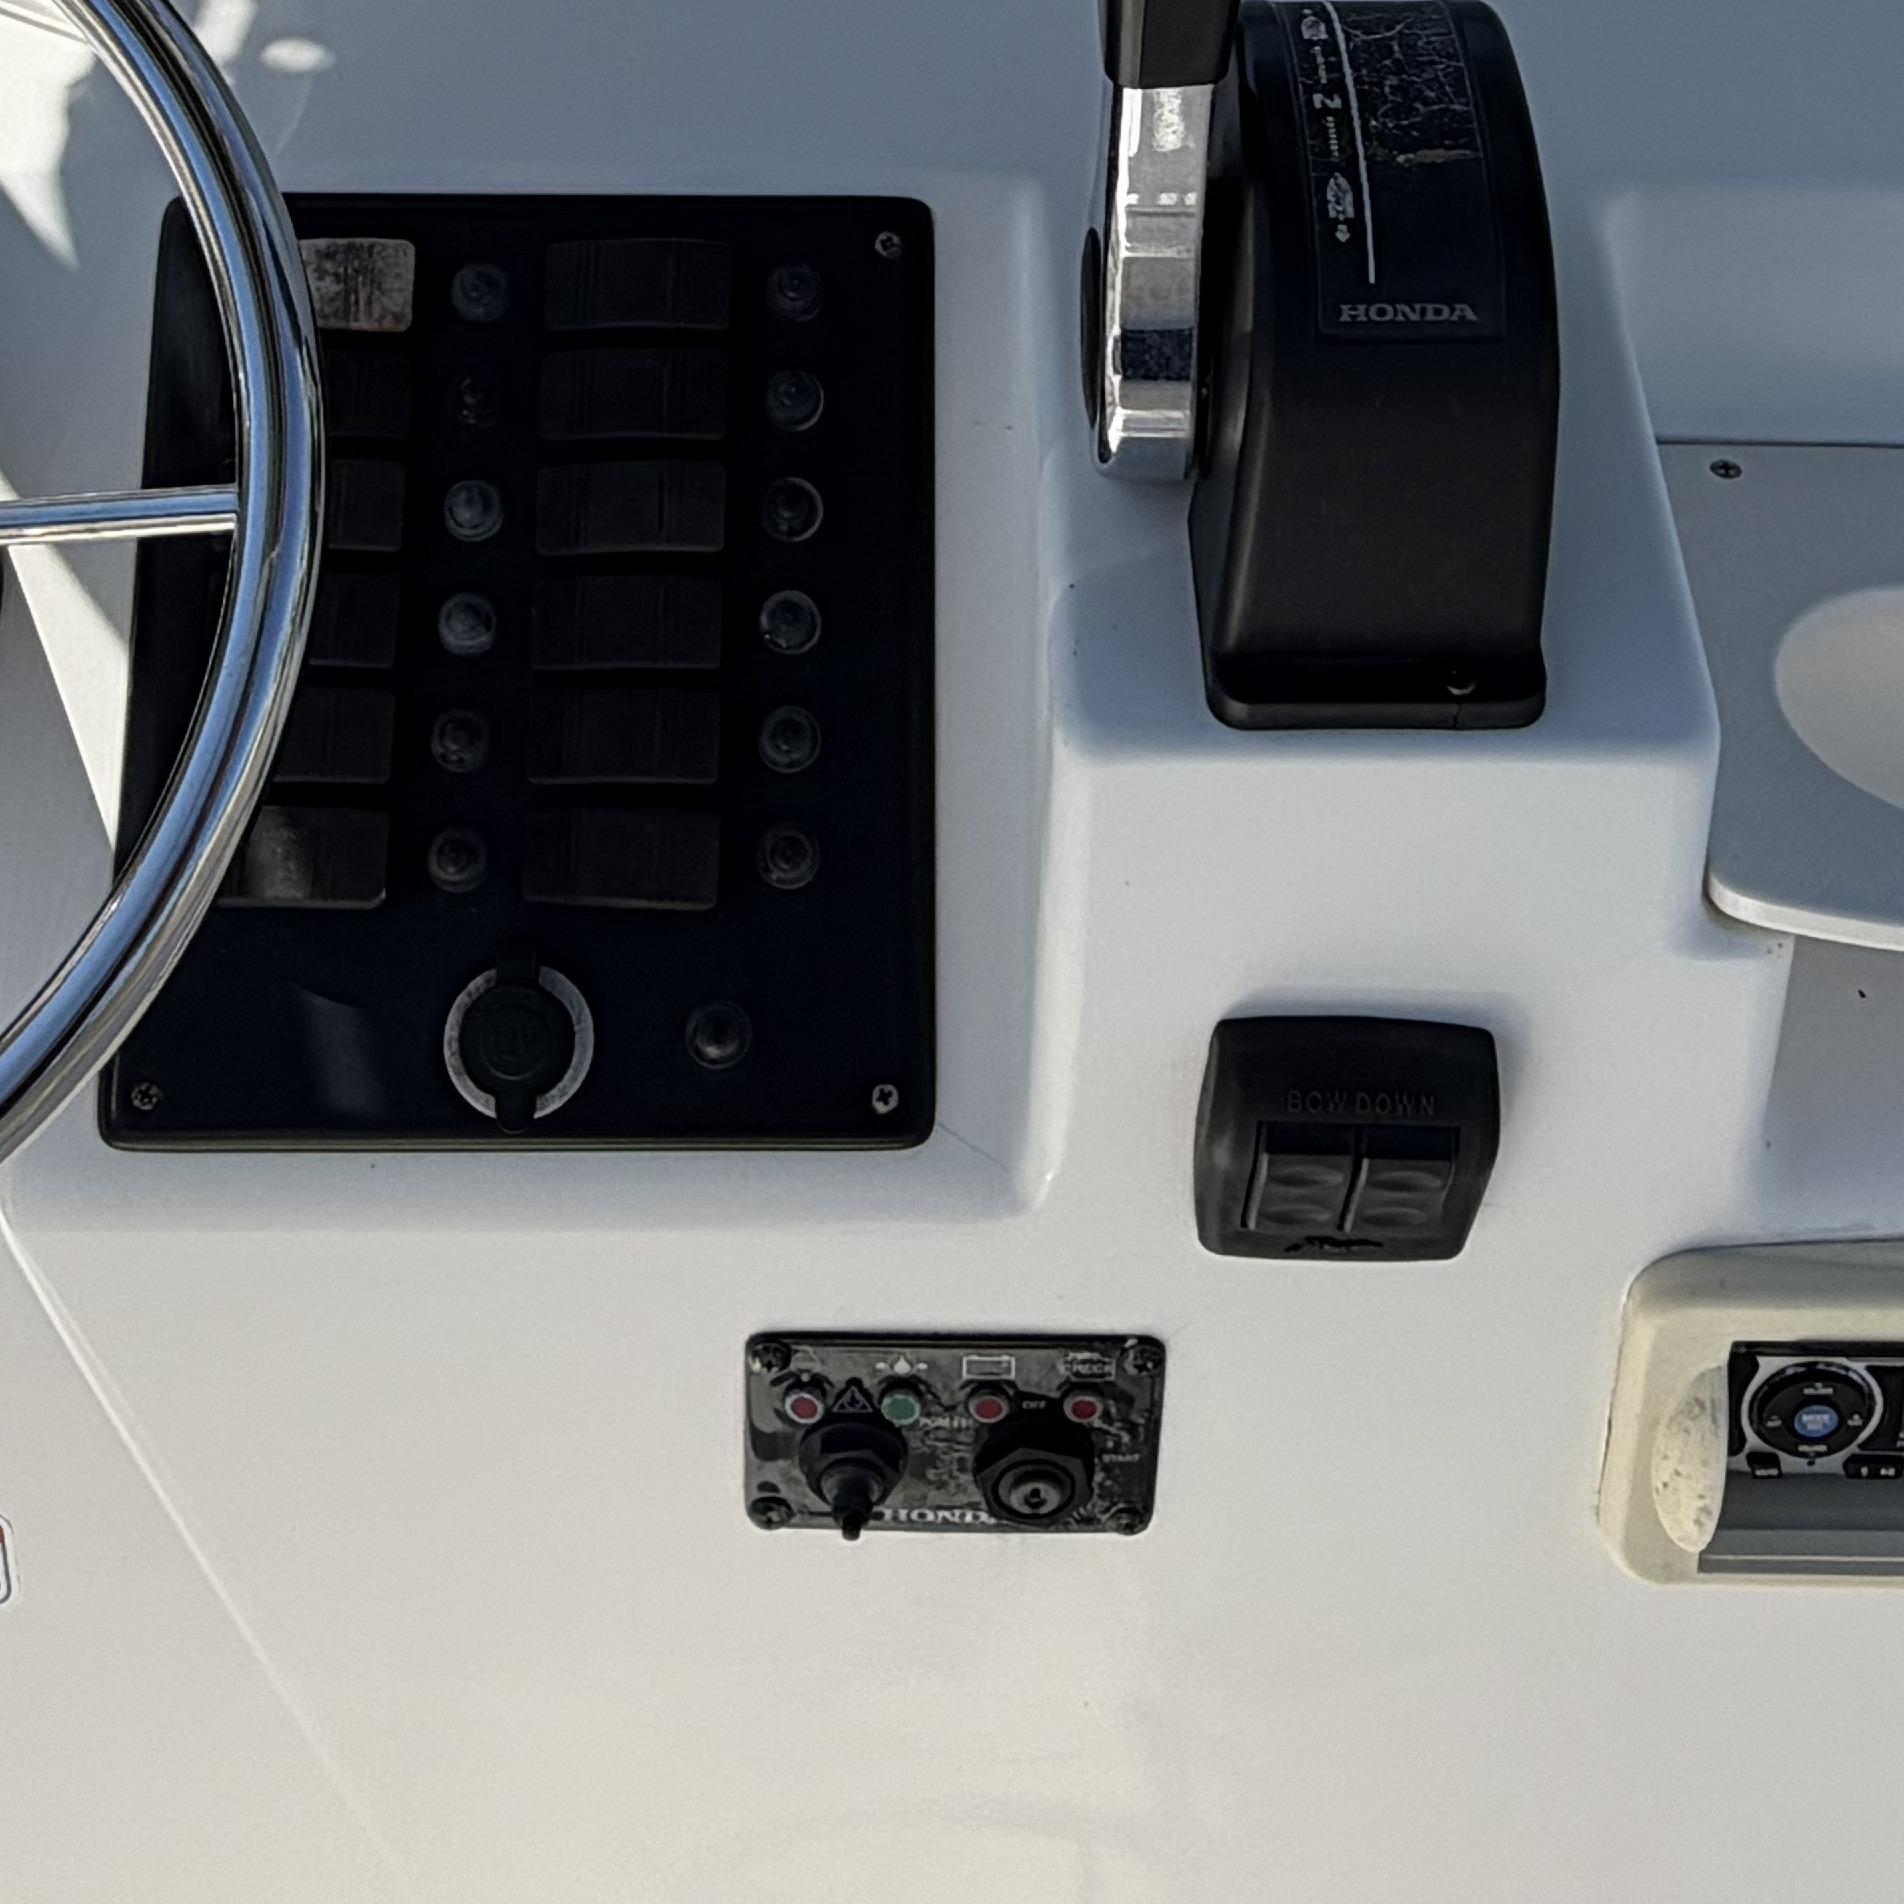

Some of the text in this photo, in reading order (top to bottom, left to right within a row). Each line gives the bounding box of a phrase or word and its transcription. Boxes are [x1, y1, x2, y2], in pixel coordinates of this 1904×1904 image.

[1337, 302, 1479, 323] HONDA
[1287, 1089, 1436, 1118] BOW DOWN
[1021, 1399, 1047, 1410] OFF
